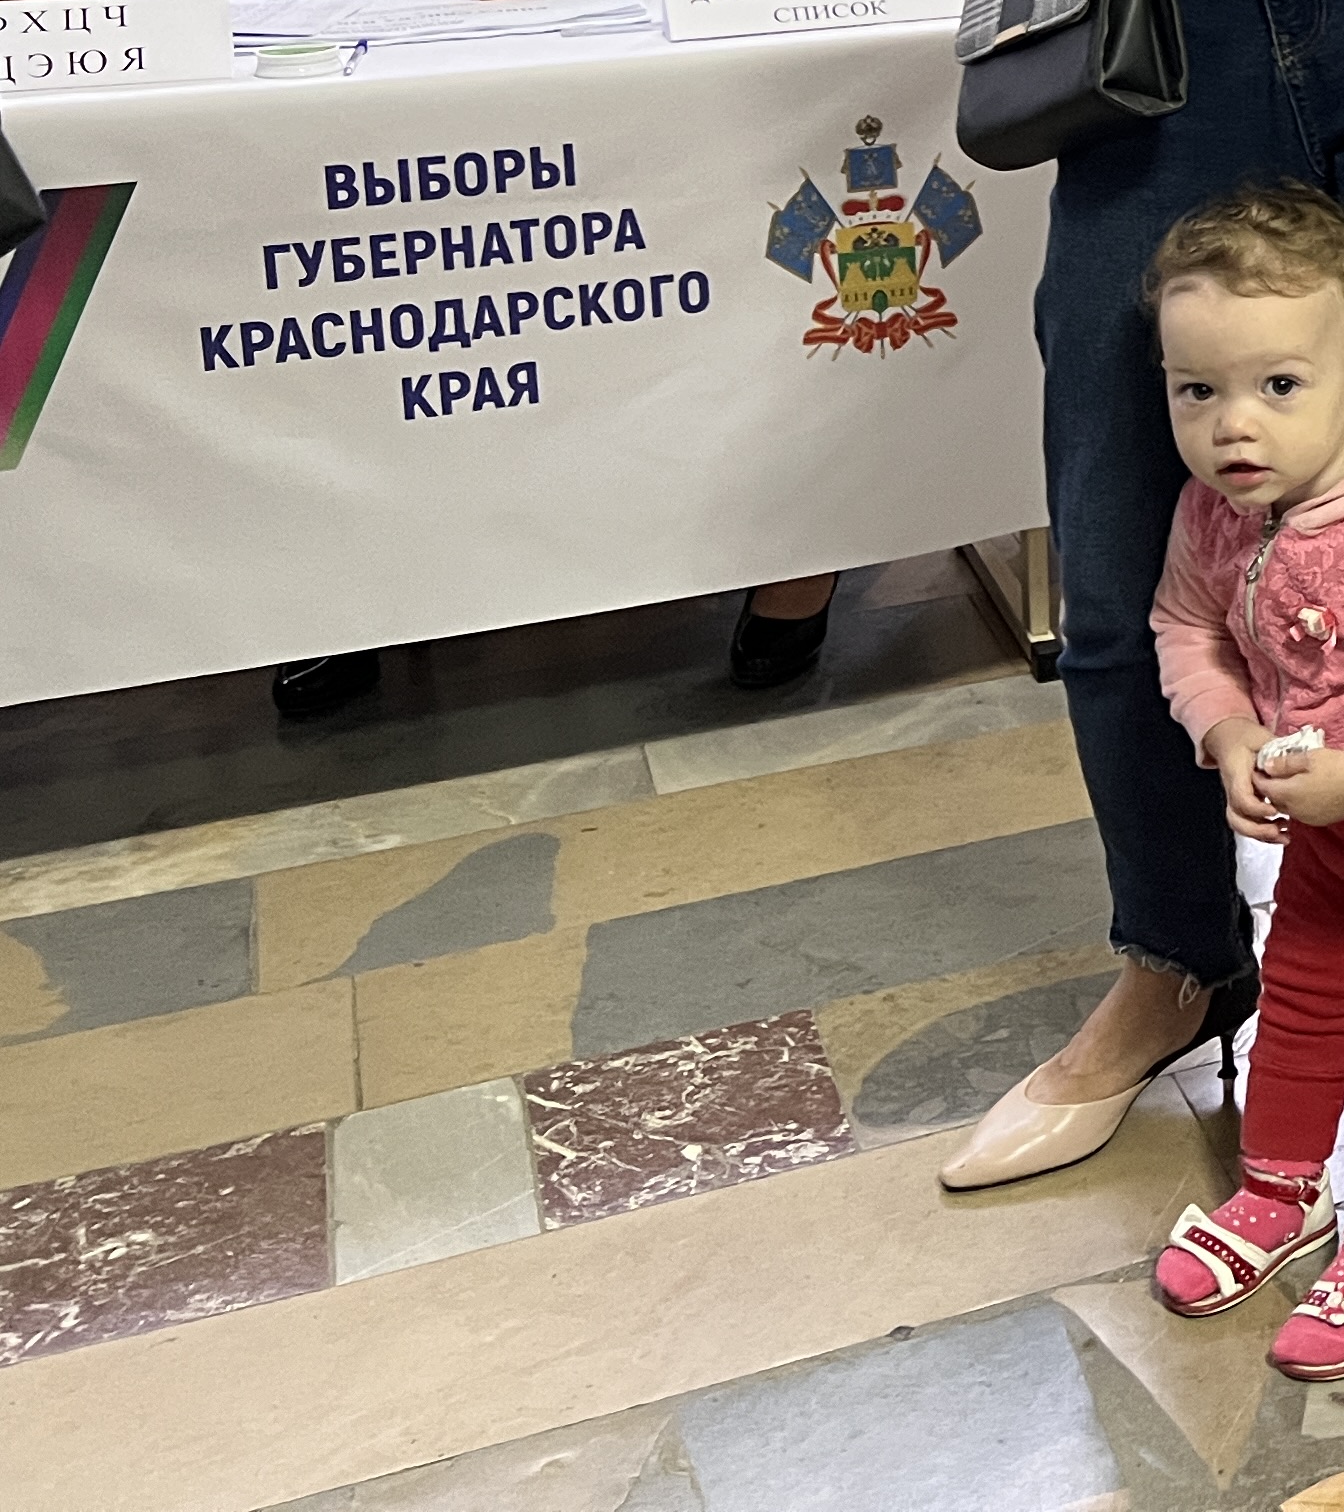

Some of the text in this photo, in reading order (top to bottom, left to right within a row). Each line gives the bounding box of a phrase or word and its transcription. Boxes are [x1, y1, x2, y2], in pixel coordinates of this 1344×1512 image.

[22, 5, 128, 35] Х Ц Ч
[773, 0, 888, 23] СПИСОК
[27, 47, 147, 78] Э Ю Я
[324, 143, 577, 210] ВЫБОРЫ
[263, 208, 646, 289] ГУБЕРНАТОРА
[200, 270, 710, 371] КРАСНОДАРСКОГО
[401, 361, 540, 420] КРАЯ
